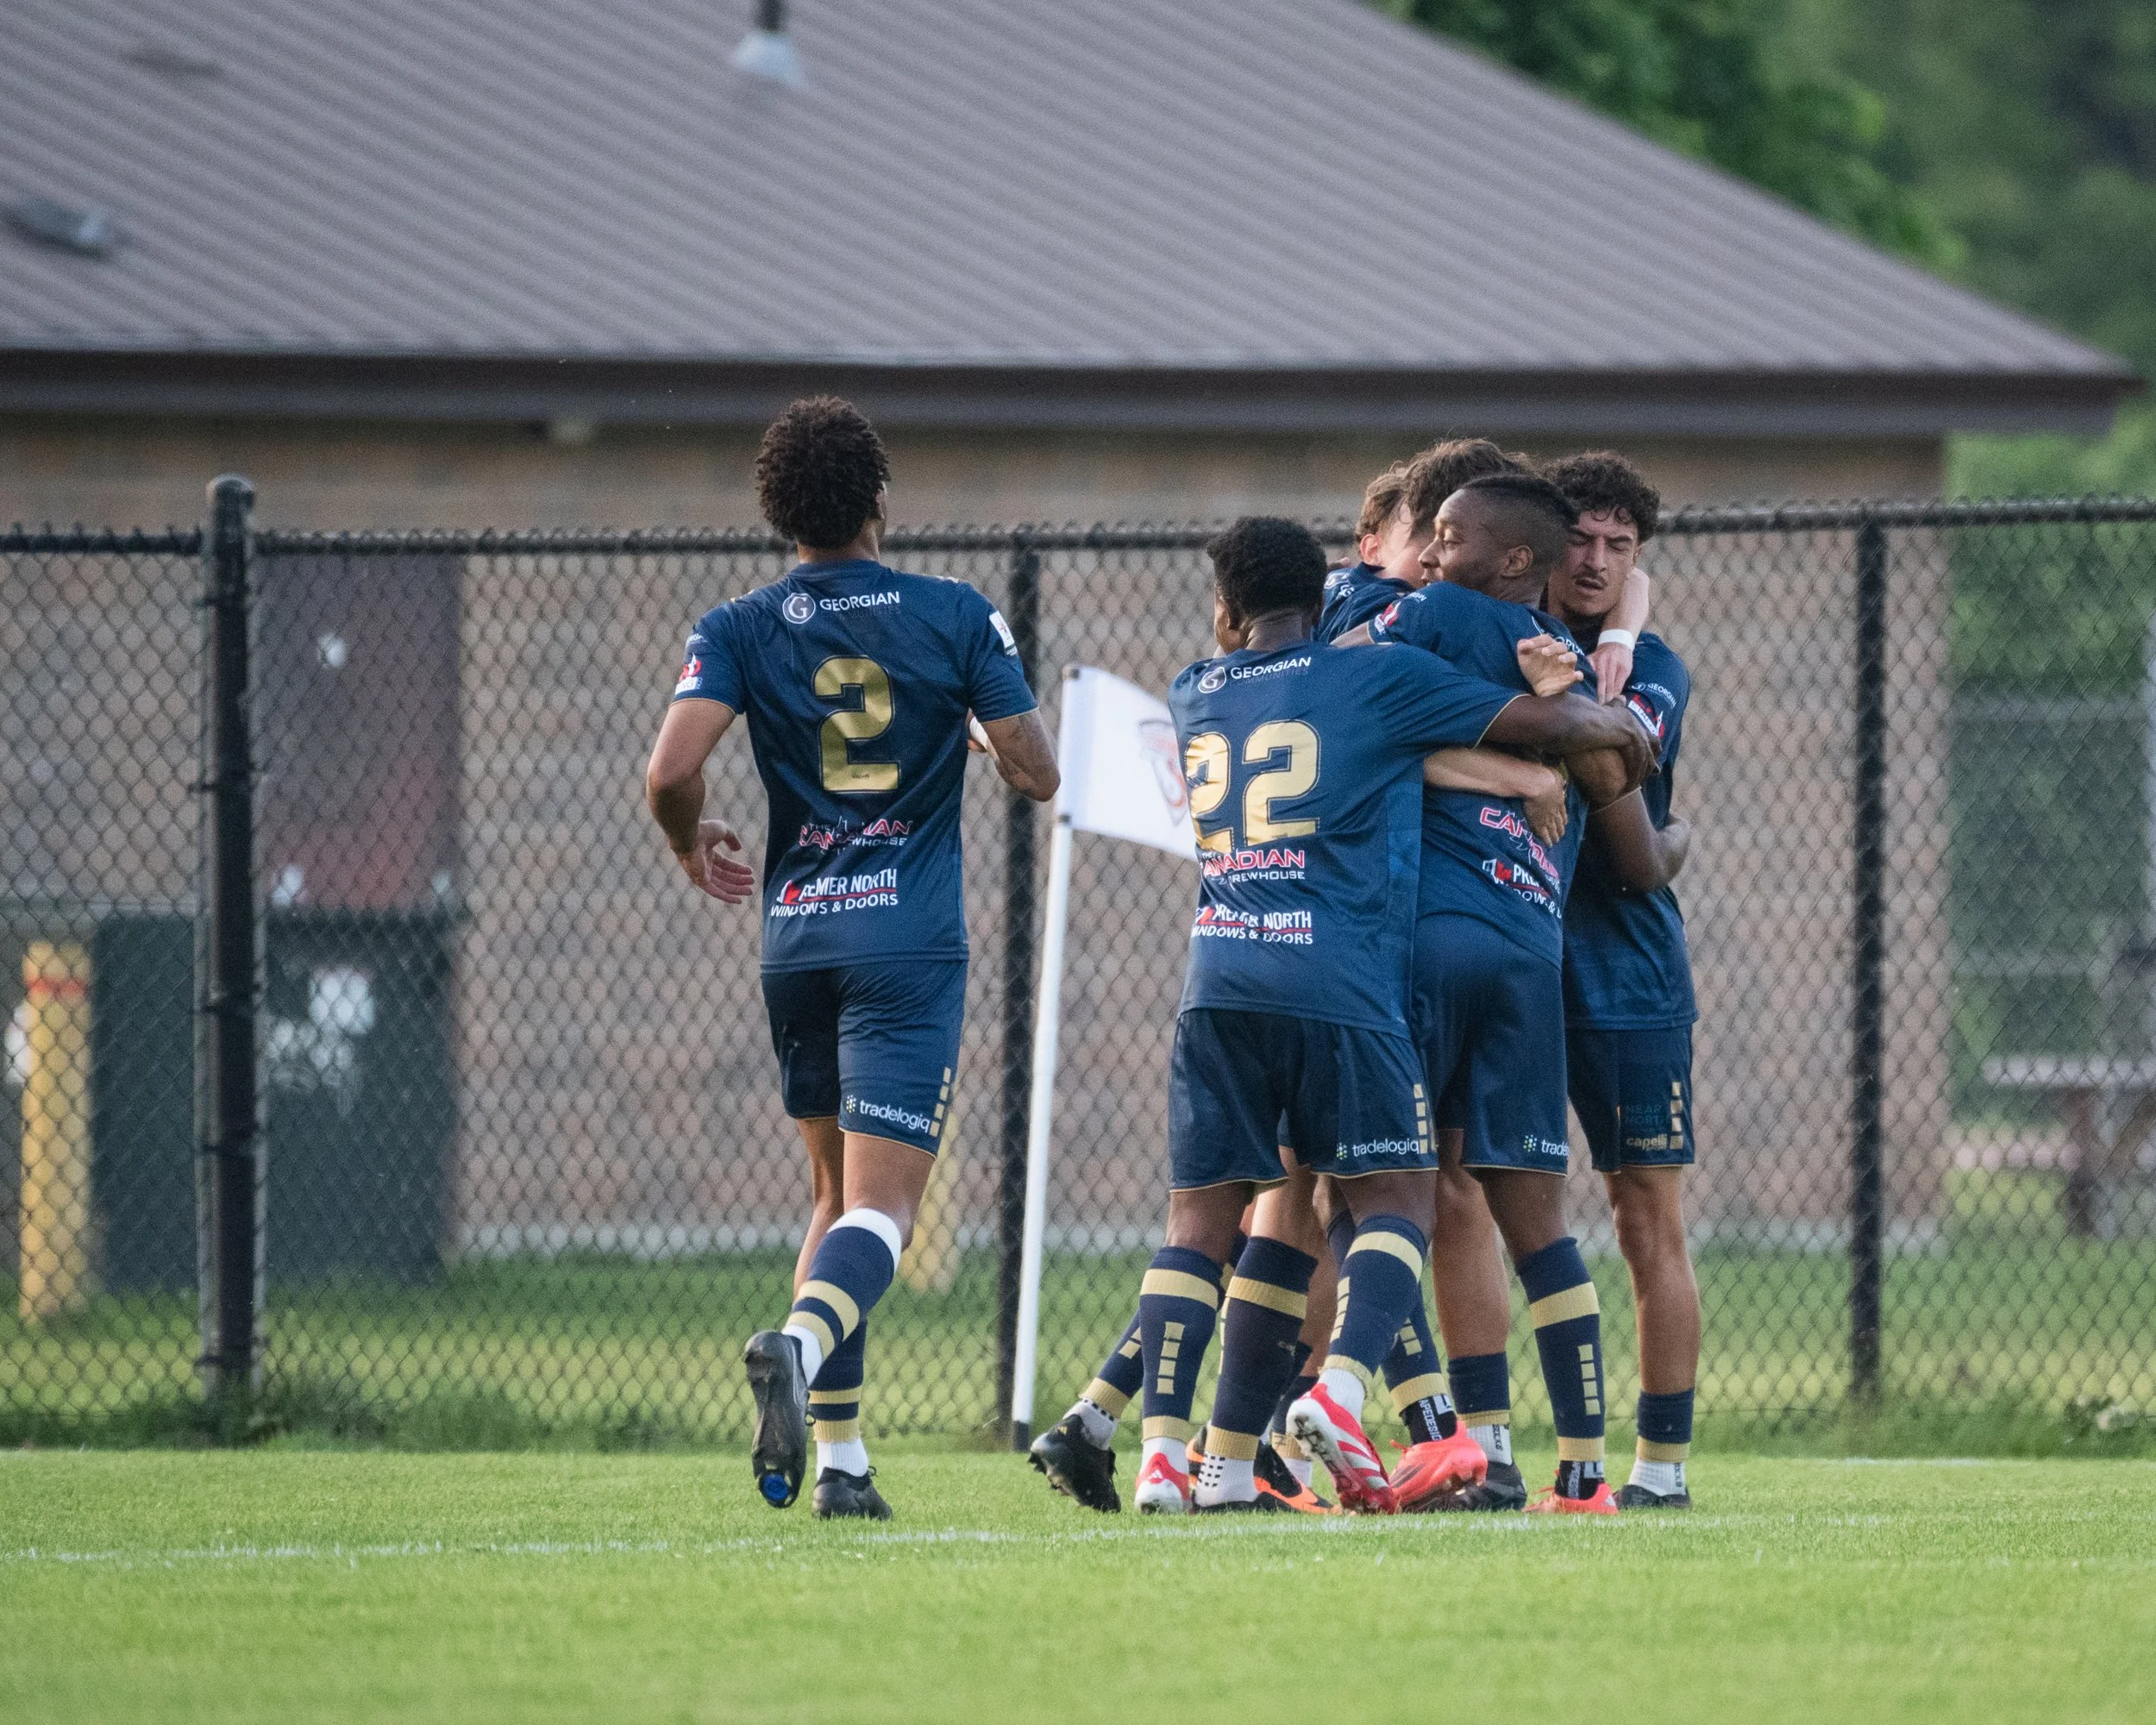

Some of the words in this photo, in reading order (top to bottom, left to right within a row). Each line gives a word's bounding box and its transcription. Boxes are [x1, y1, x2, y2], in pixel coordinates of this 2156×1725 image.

[819, 591, 901, 612] GEORGIAN
[1230, 656, 1311, 680] GEORGIAN
[811, 655, 900, 794] 2
[1185, 718, 1322, 856] 22
[832, 901, 842, 913] &
[845, 893, 899, 911] DOORS
[1263, 910, 1312, 930] NORTH
[1249, 930, 1259, 940] &
[1263, 932, 1313, 944] DOORS
[859, 1100, 931, 1134] tradelogiq
[1351, 1138, 1420, 1157] tradelogiq
